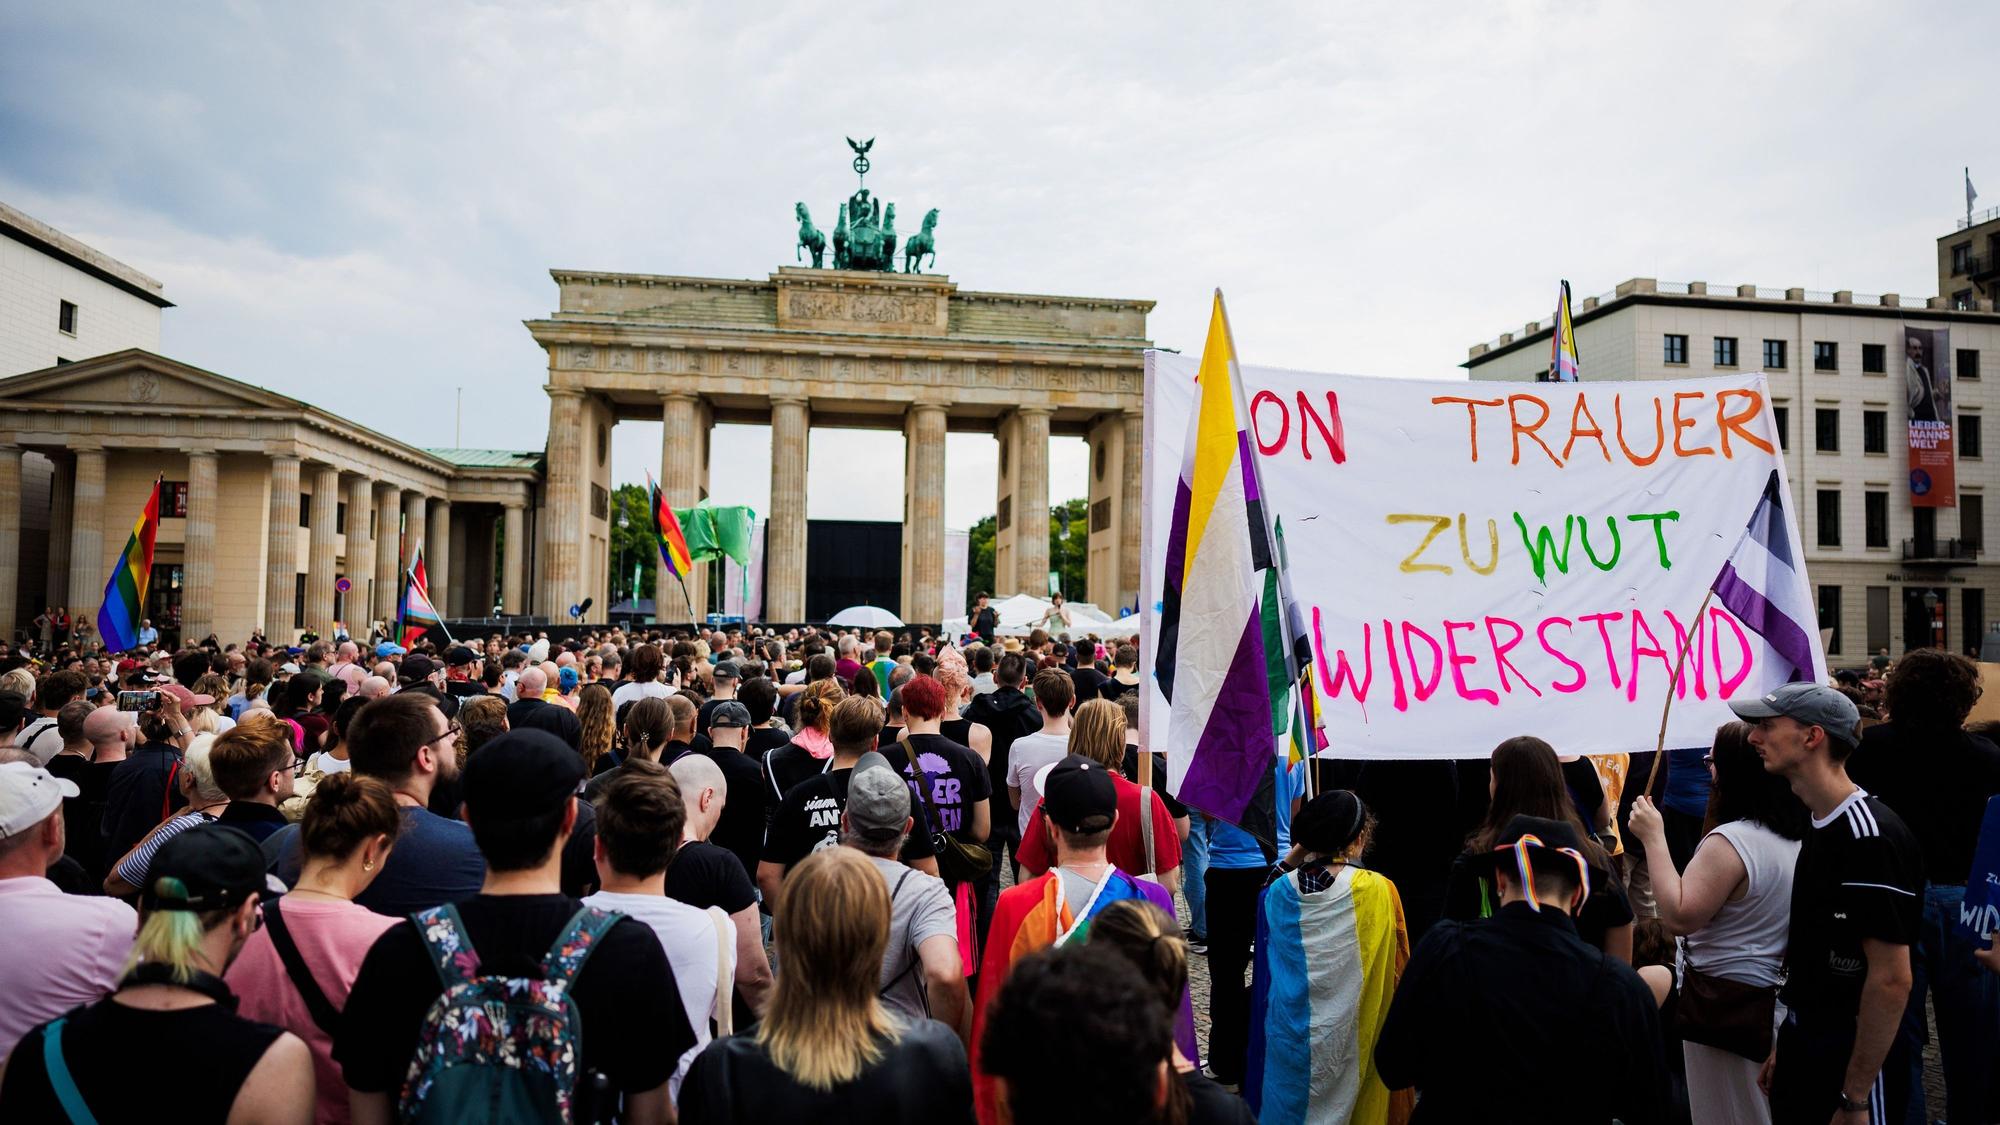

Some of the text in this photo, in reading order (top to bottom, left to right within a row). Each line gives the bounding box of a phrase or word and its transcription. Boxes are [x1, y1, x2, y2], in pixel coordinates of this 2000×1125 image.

[1432, 390, 1775, 469] TRAUER
[1908, 420, 1951, 430] LIEBER-
[1909, 430, 1951, 440] MANNS
[1909, 439, 1939, 449] WELT
[1386, 511, 1681, 587] ZU WUT
[1311, 606, 1754, 713] WIDERSTAND
[804, 796, 839, 811] siam
